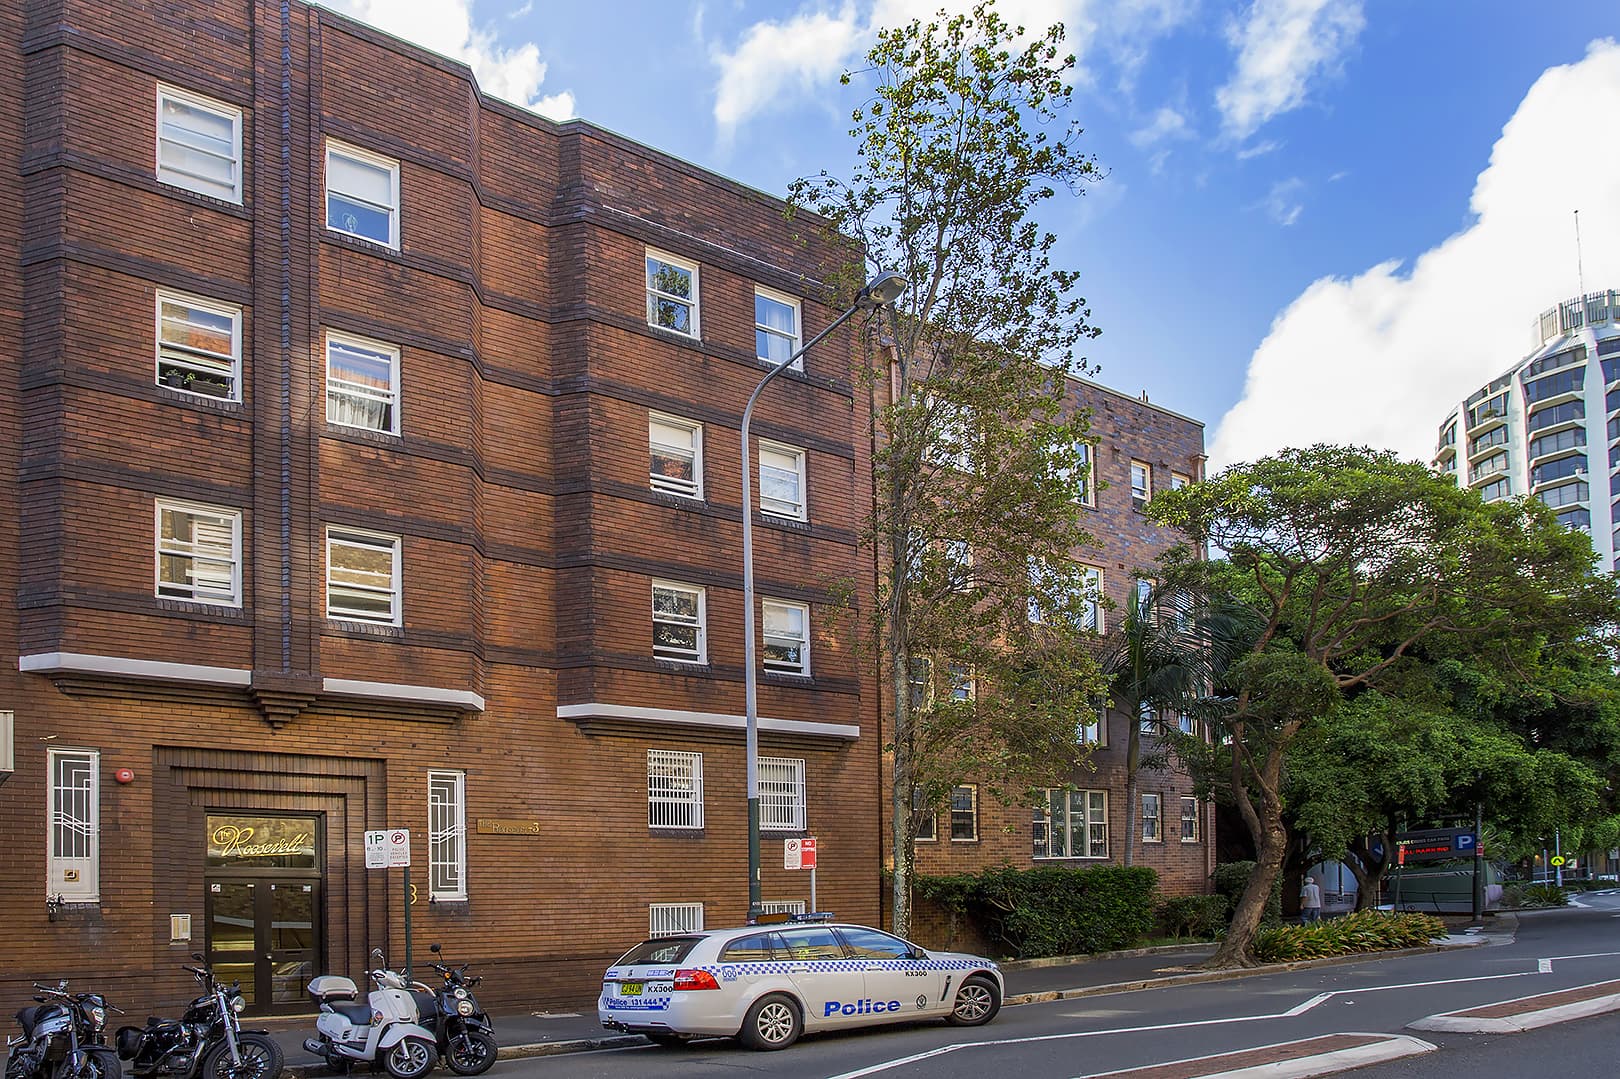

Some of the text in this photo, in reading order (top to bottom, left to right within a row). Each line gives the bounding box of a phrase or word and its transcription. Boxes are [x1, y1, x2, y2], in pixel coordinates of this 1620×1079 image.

[213, 826, 309, 857] Roosevelt
[368, 834, 385, 845] 1P
[1458, 835, 1473, 849] P
[648, 984, 673, 993] KX300
[823, 998, 901, 1017] Police
